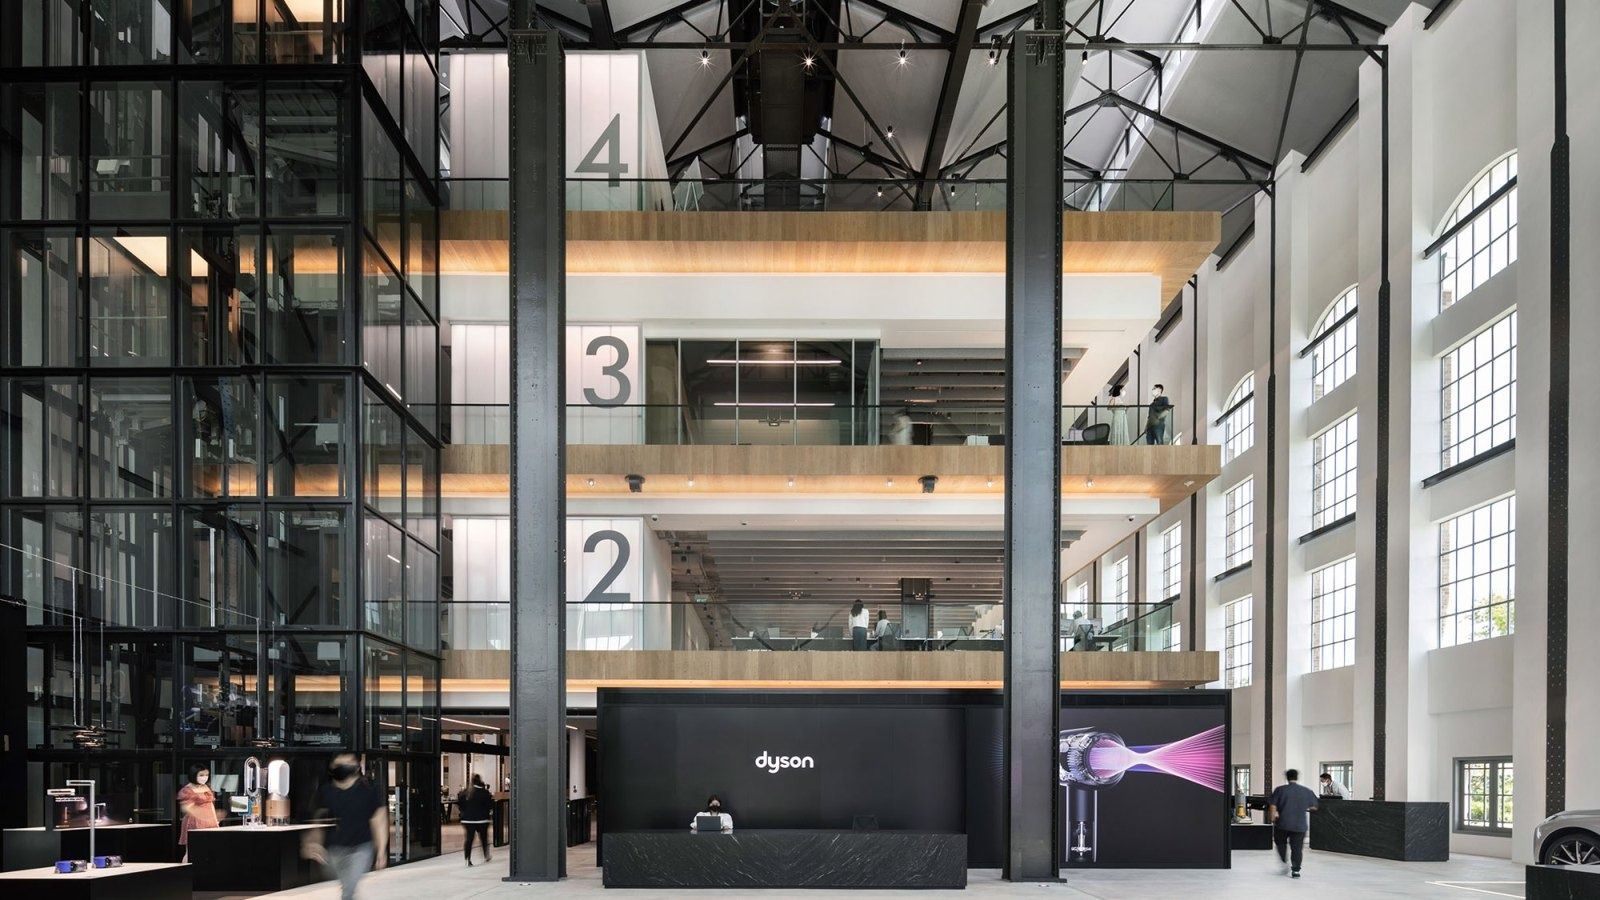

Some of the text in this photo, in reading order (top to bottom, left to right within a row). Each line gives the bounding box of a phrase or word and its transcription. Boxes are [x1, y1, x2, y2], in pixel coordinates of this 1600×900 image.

[574, 113, 628, 187] 4
[583, 335, 631, 409] 3
[583, 529, 630, 603] 2
[755, 750, 814, 773] dyson
